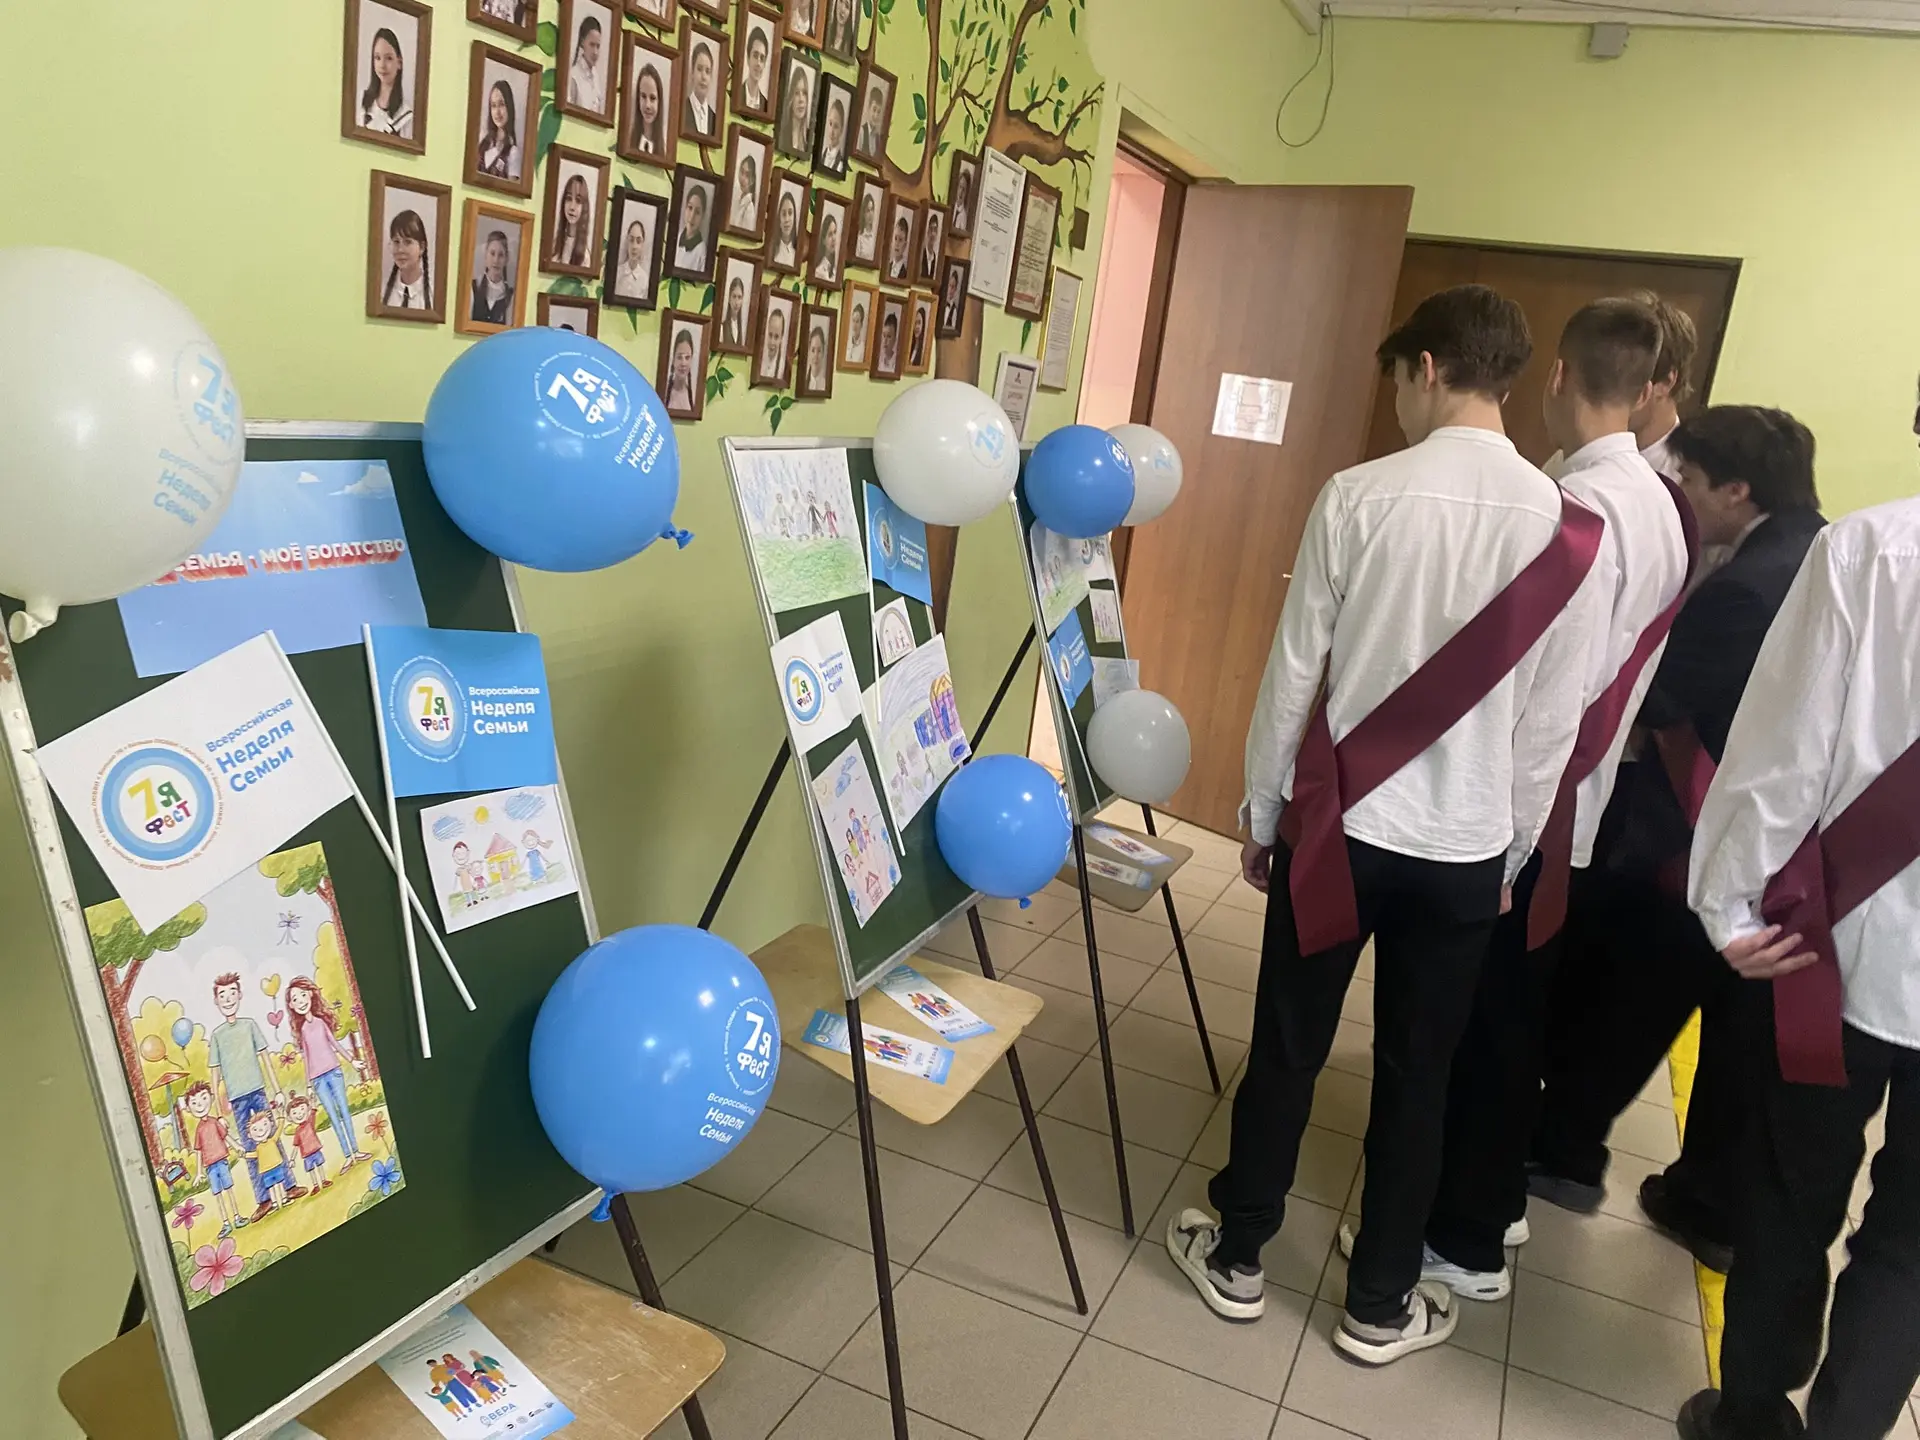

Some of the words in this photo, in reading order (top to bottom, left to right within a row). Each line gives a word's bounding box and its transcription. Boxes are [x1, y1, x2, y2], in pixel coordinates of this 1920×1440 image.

[547, 367, 602, 414] 7Я
[259, 542, 304, 566] МОЁ
[306, 538, 406, 563] БОГАТСТВО
[416, 686, 448, 716] 7Я
[468, 685, 541, 698] Всероссийская
[471, 700, 536, 717] Неделя
[205, 698, 294, 752] Всероссийская
[473, 719, 529, 735] Семьи
[216, 719, 295, 775] Неделя
[228, 745, 295, 793] Семьи
[127, 777, 183, 821] 7Я
[744, 1011, 772, 1059] 7Я
[699, 1123, 733, 1144] Семьи
[705, 1107, 746, 1131] Неделя
